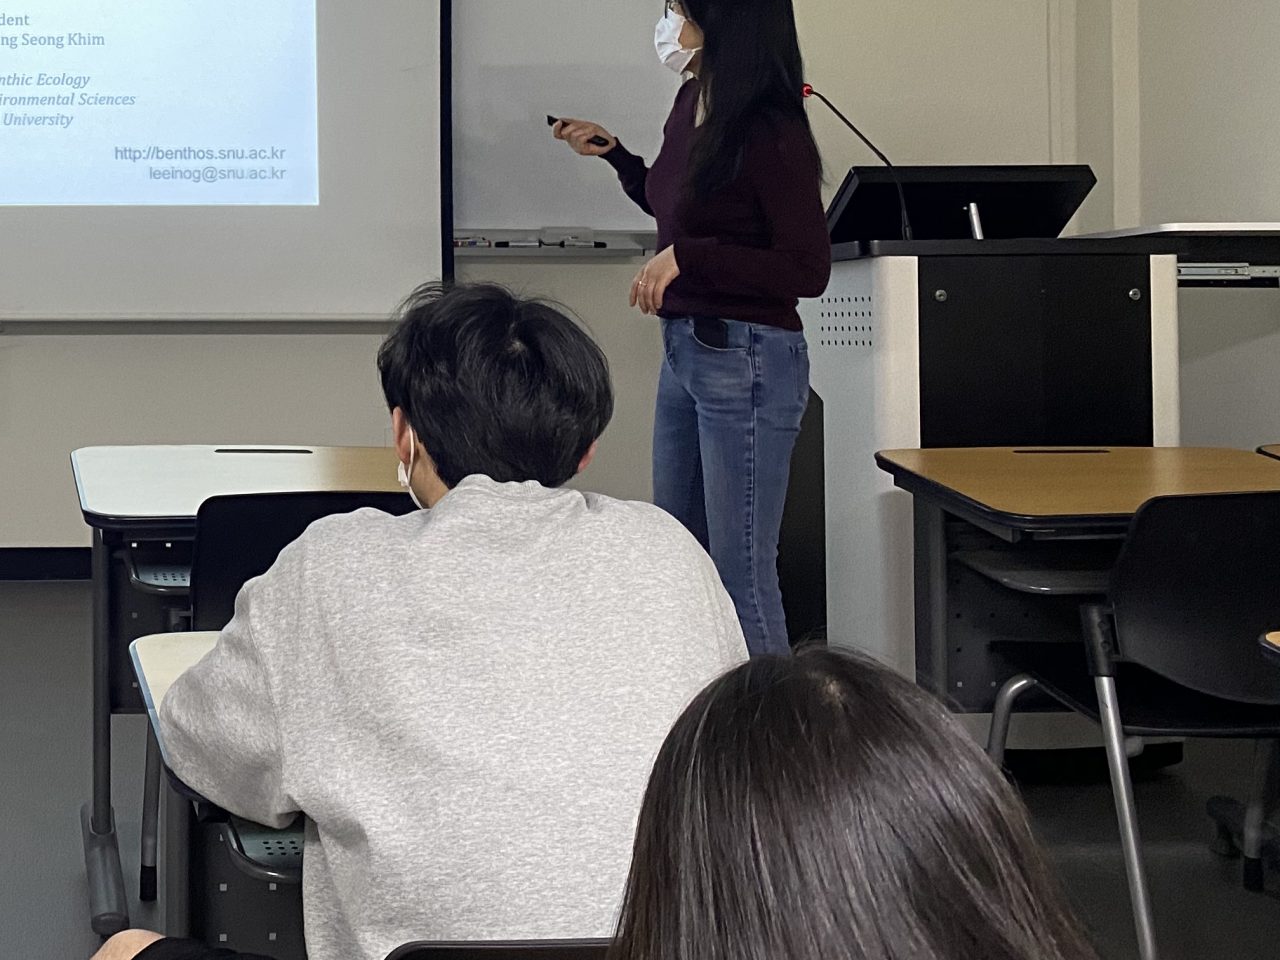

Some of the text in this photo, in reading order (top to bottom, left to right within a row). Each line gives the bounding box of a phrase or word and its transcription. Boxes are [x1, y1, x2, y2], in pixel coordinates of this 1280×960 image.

[22, 34, 64, 50] Seong
[67, 33, 105, 47] Khim
[36, 73, 91, 90] Ecology
[78, 93, 136, 107] Sciences
[3, 113, 74, 130] University
[114, 145, 286, 163] http://benthos.snu.ac.kr
